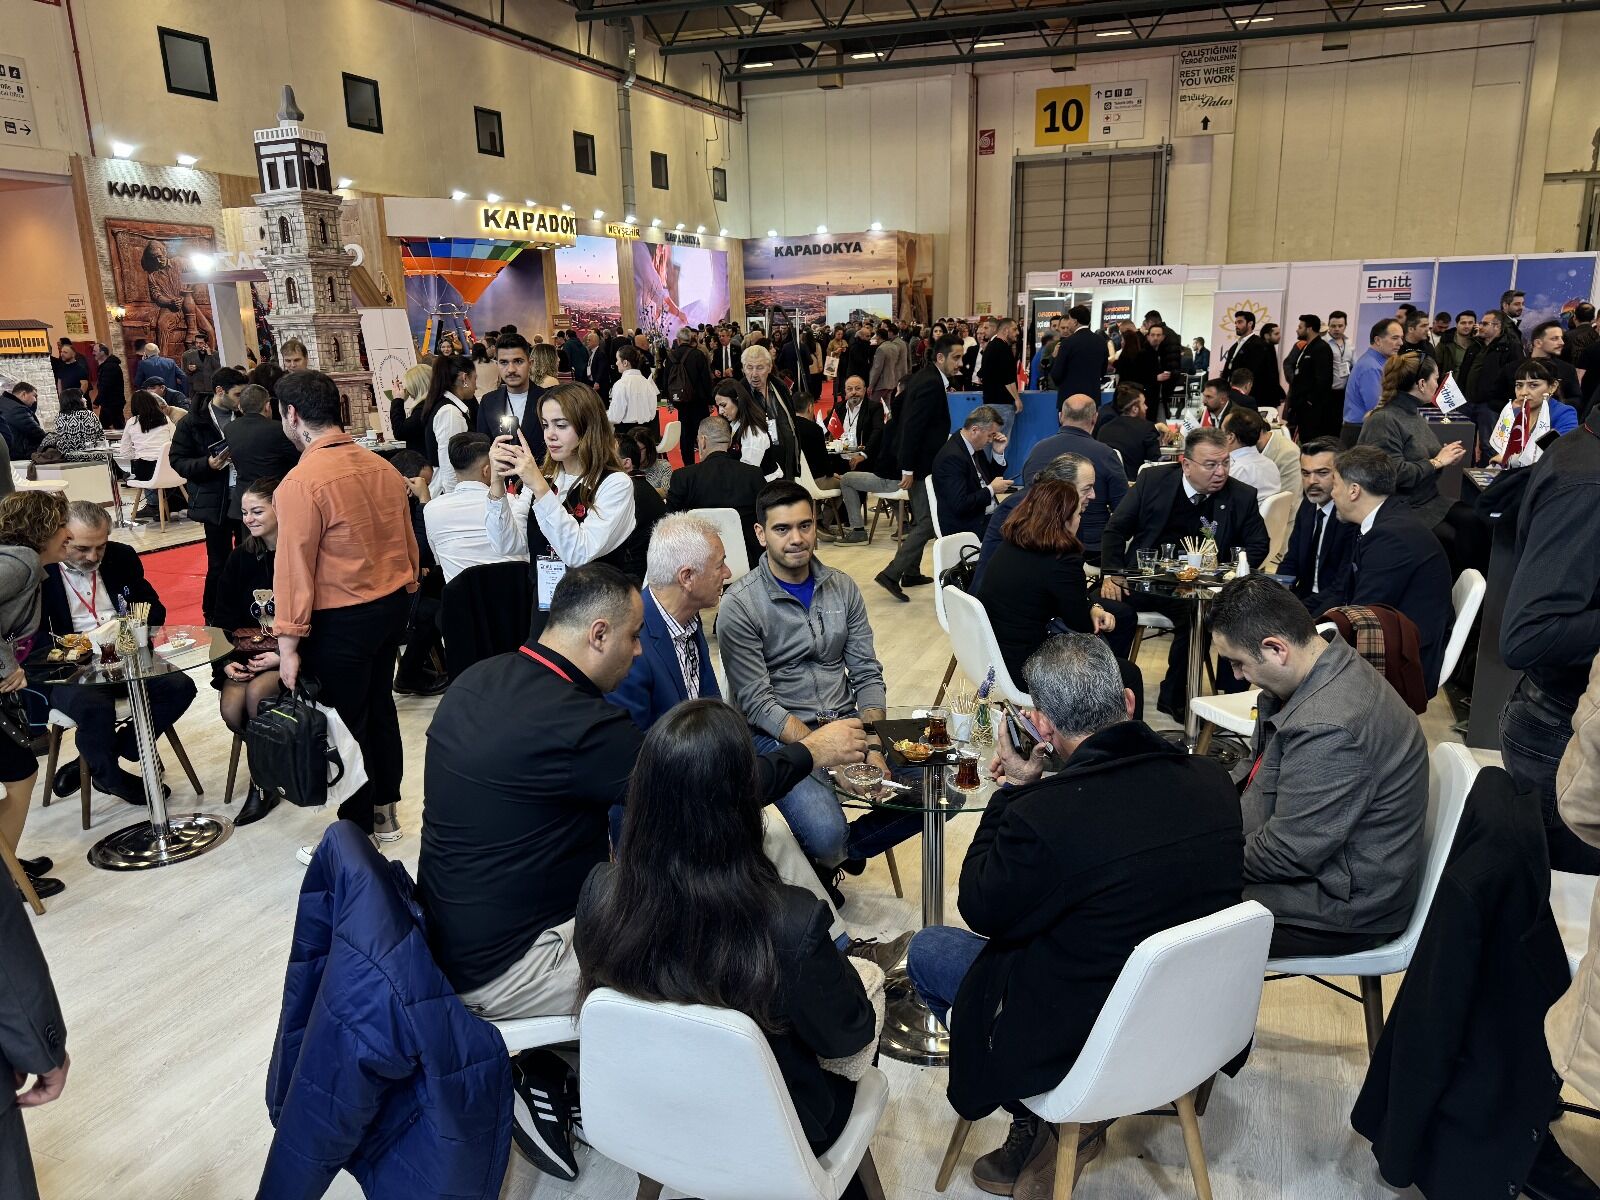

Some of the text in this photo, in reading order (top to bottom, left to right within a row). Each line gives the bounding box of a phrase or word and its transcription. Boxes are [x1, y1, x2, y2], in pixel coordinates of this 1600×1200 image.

[1181, 53, 1237, 65] YERDE DİNLENİN
[1180, 65, 1236, 78] REST WHERE
[1180, 74, 1235, 87] YOU WORK
[1043, 98, 1084, 133] 10
[107, 180, 202, 205] KAPADOKYA
[774, 241, 863, 258] KAPADOKYA
[1080, 268, 1173, 279] KAPADOKYA EMİN KOÇAK
[1098, 278, 1128, 286] TERMAL
[1367, 275, 1412, 289] Emitt
